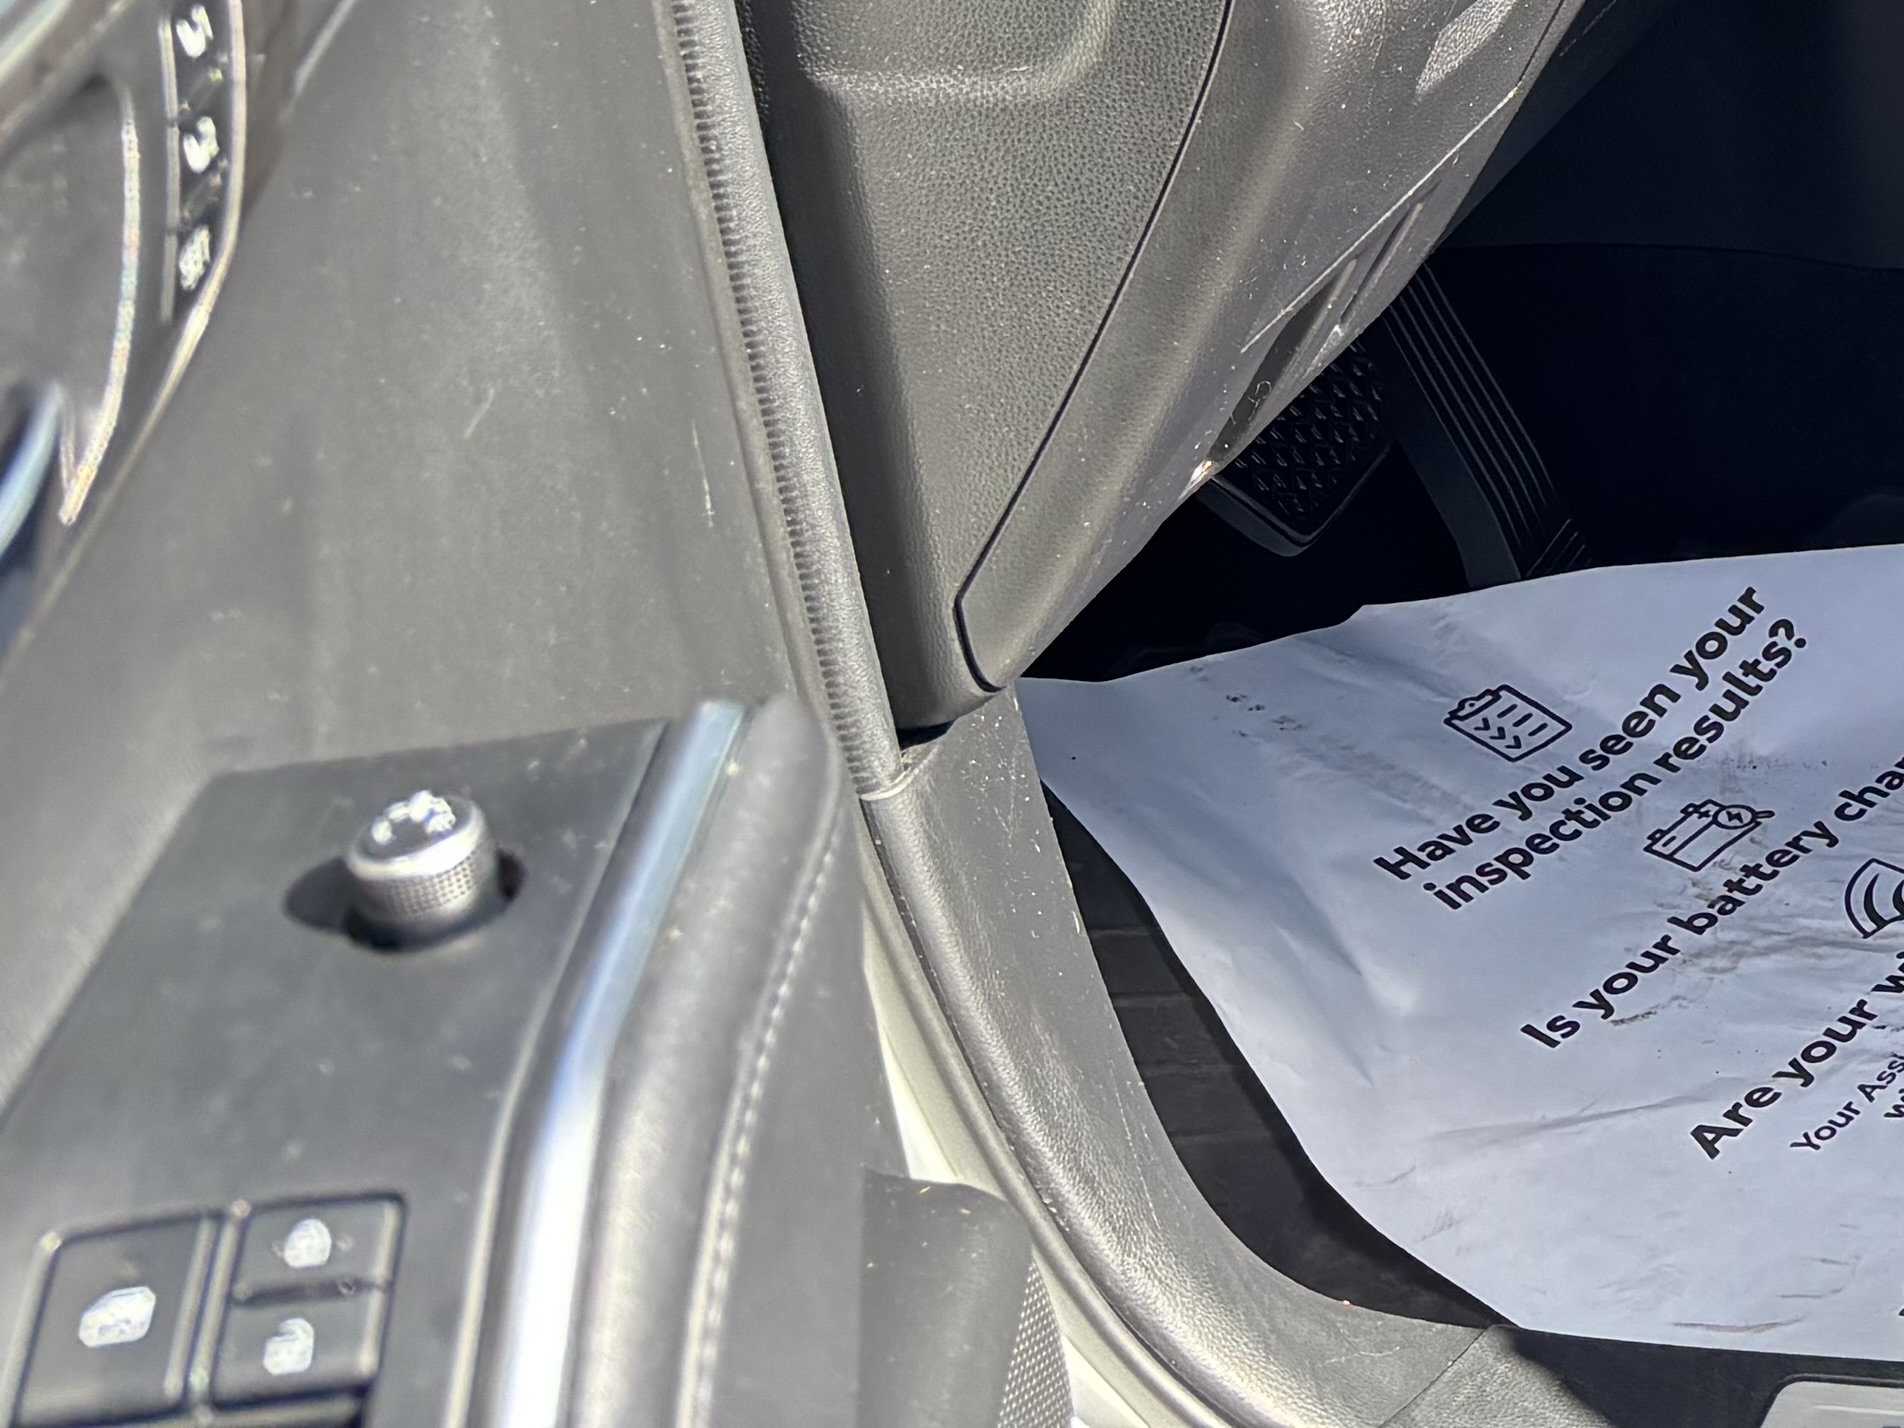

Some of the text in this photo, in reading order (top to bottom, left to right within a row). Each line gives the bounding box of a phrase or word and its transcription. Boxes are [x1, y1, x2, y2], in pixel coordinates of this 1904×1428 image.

[1373, 586, 1793, 880] Have you seen your
[1423, 618, 1807, 910] inspection results?
[1520, 1015, 1581, 1049] Is
[1572, 934, 1681, 1020] your
[1669, 820, 1839, 936] battery
[1690, 1086, 1782, 1160] Are
[1772, 998, 1887, 1088] your
[1789, 1101, 1861, 1150] Your
